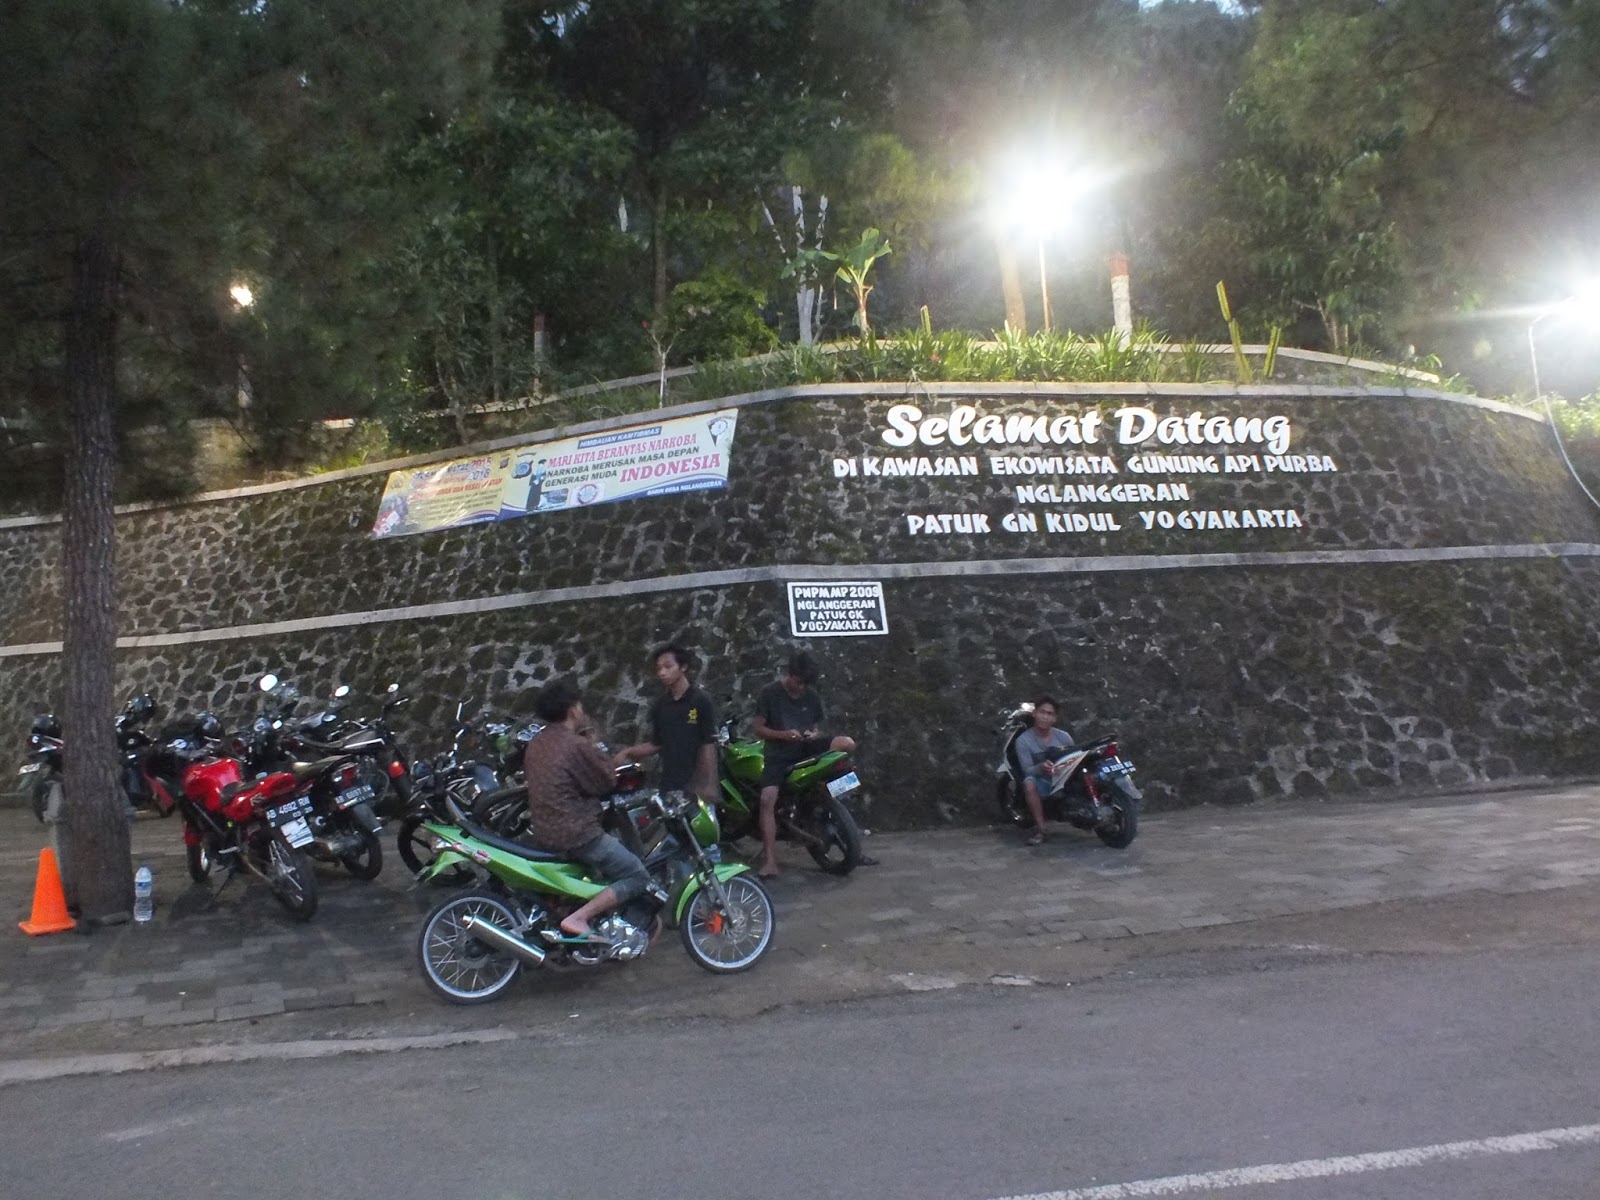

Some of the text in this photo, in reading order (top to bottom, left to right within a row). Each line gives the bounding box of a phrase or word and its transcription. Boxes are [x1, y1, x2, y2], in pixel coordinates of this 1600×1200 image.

[882, 405, 1291, 455] Selamat Datang
[547, 433, 697, 468] MARI KITA BERANTAS NARKOBA
[580, 436, 616, 447] HIMBAUAN
[545, 454, 720, 487] GENERASI MUDA INDONESIA
[546, 446, 700, 477] NARKOBA MERUSAK MASA DEPAN
[833, 455, 1337, 477] DI KAWASAN EKOWISATA GUNUNG API PURBA
[1016, 483, 1190, 503] NGLANGGERAN
[907, 509, 1302, 535] PATUK GN KIDUL YOGYAKARTA
[797, 600, 876, 610] NGLANGGERAN
[810, 610, 865, 620] PATUK GK
[800, 620, 877, 631] YOGYAKARTA
[266, 809, 277, 820] AB
